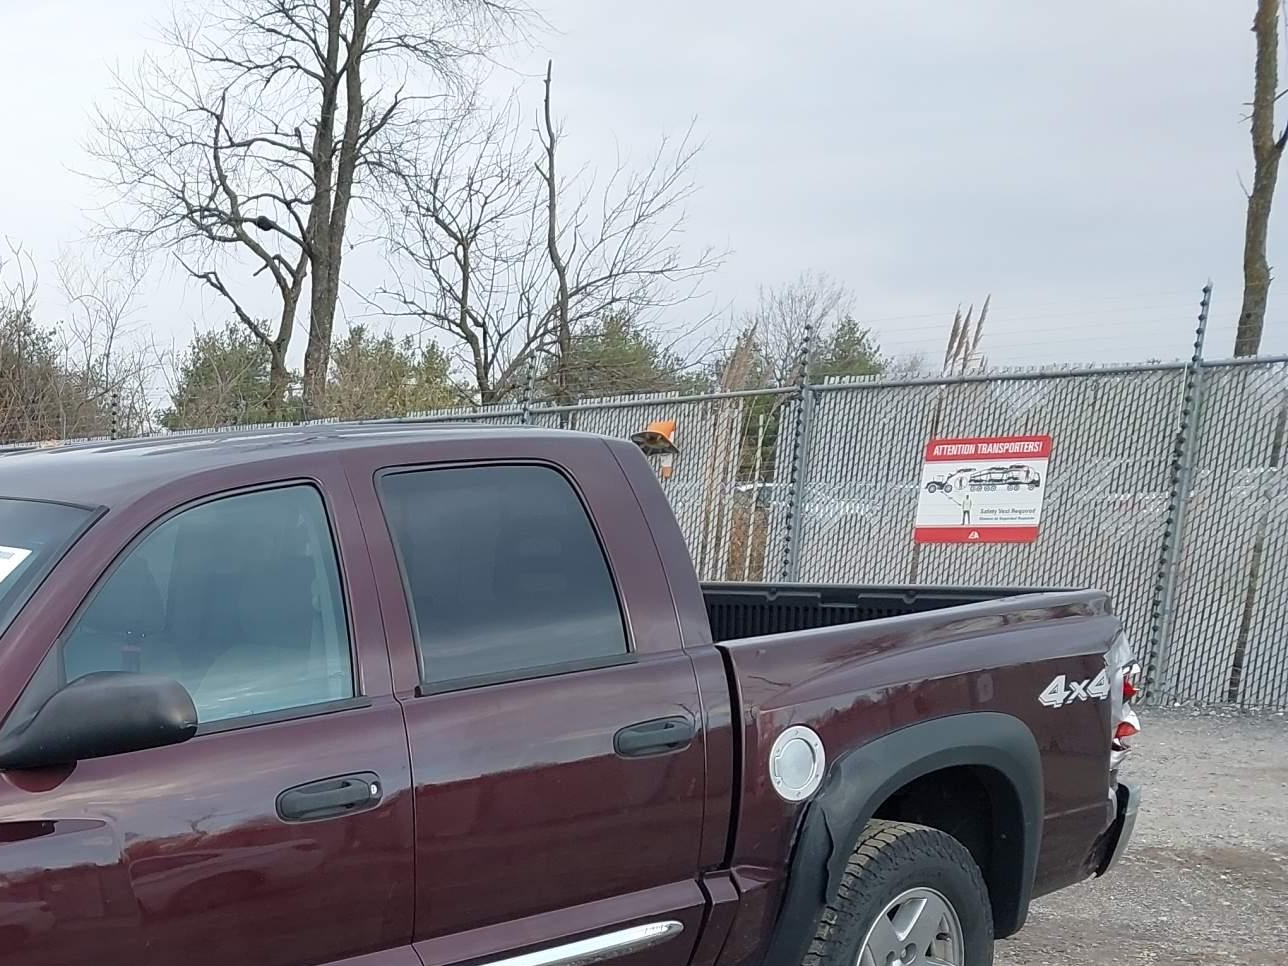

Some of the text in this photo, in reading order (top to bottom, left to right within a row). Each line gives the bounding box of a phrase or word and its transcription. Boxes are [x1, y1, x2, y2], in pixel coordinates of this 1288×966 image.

[933, 441, 1043, 456] ATTENTION TRANSPORTERS!
[1038, 668, 1111, 708] 4x4
